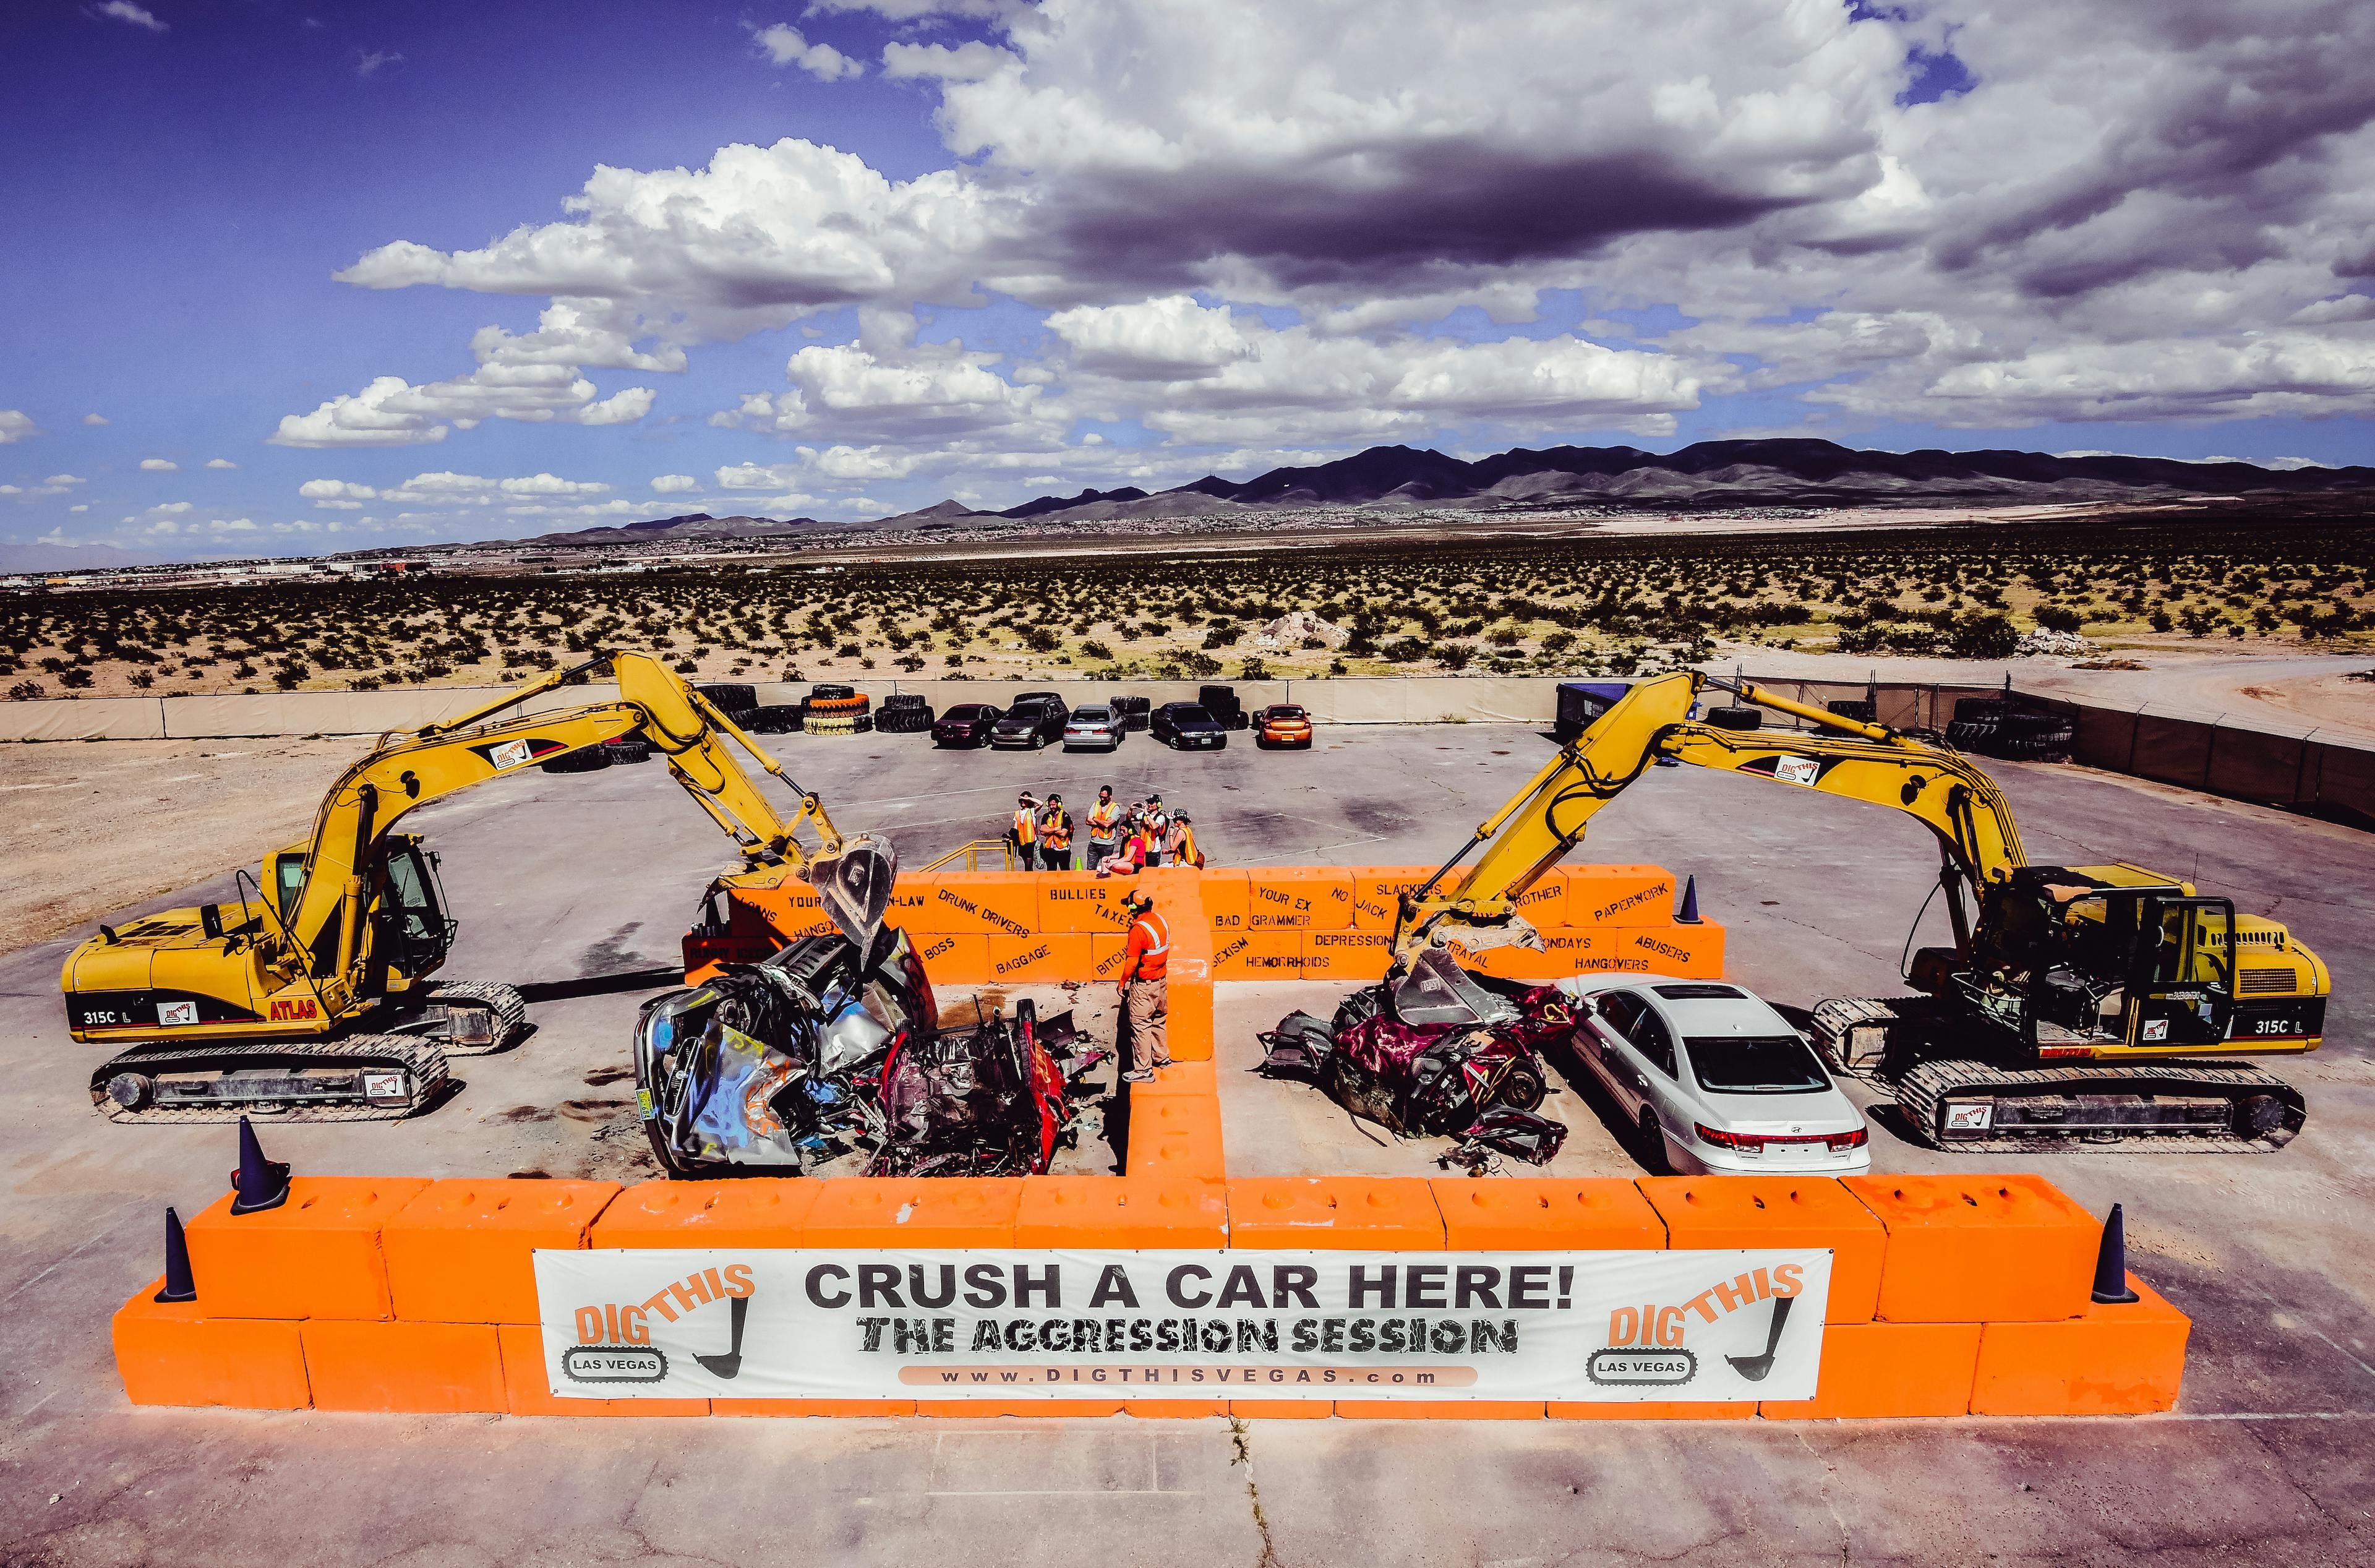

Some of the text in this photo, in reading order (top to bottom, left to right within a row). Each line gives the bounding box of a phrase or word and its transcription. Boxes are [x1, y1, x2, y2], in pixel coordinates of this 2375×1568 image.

[497, 740, 525, 762] DIG THIS
[1782, 765, 1796, 773] DIG
[1050, 888, 1106, 900] BULLIES
[1259, 886, 1311, 912] YOUR EX
[1512, 886, 1562, 908] ROTHER
[789, 896, 924, 907] YOUR N-LAW
[1331, 887, 1387, 919] NO JACK
[1594, 882, 1668, 921] PAPERWORK
[938, 889, 1030, 939] DRUNK DRIVERS
[1095, 904, 1134, 928] TAXES
[1215, 915, 1311, 926] BAD GRAMMER
[1316, 935, 1392, 946] DEPRESSION
[1543, 938, 1591, 948] ONDAYS
[924, 938, 955, 960] BOSS
[1634, 935, 1691, 963] ABUSERS
[996, 944, 1051, 974] BAGGAGE
[1247, 957, 1329, 967] HEMORRHOIDS
[1575, 958, 1649, 970] HANGOVERS
[175, 1003, 190, 1013] THIS
[271, 1000, 317, 1021] ATLAS
[84, 1011, 131, 1024] 315C L
[2256, 1020, 2303, 1034] 315C L
[2041, 1048, 2091, 1058] BRUTUS
[381, 1076, 398, 1086] THIS
[1967, 1107, 1987, 1116] THIS
[805, 1264, 1574, 1310] CRUSH A CAR HERE!
[575, 1263, 755, 1346] DIG THIS
[1608, 1264, 1804, 1347] DIG THIS
[855, 1317, 1518, 1355] THE AGGRESSION SESSION
[573, 1360, 657, 1371] LAS VEGAS
[1598, 1362, 1685, 1373] LAS VEGAS
